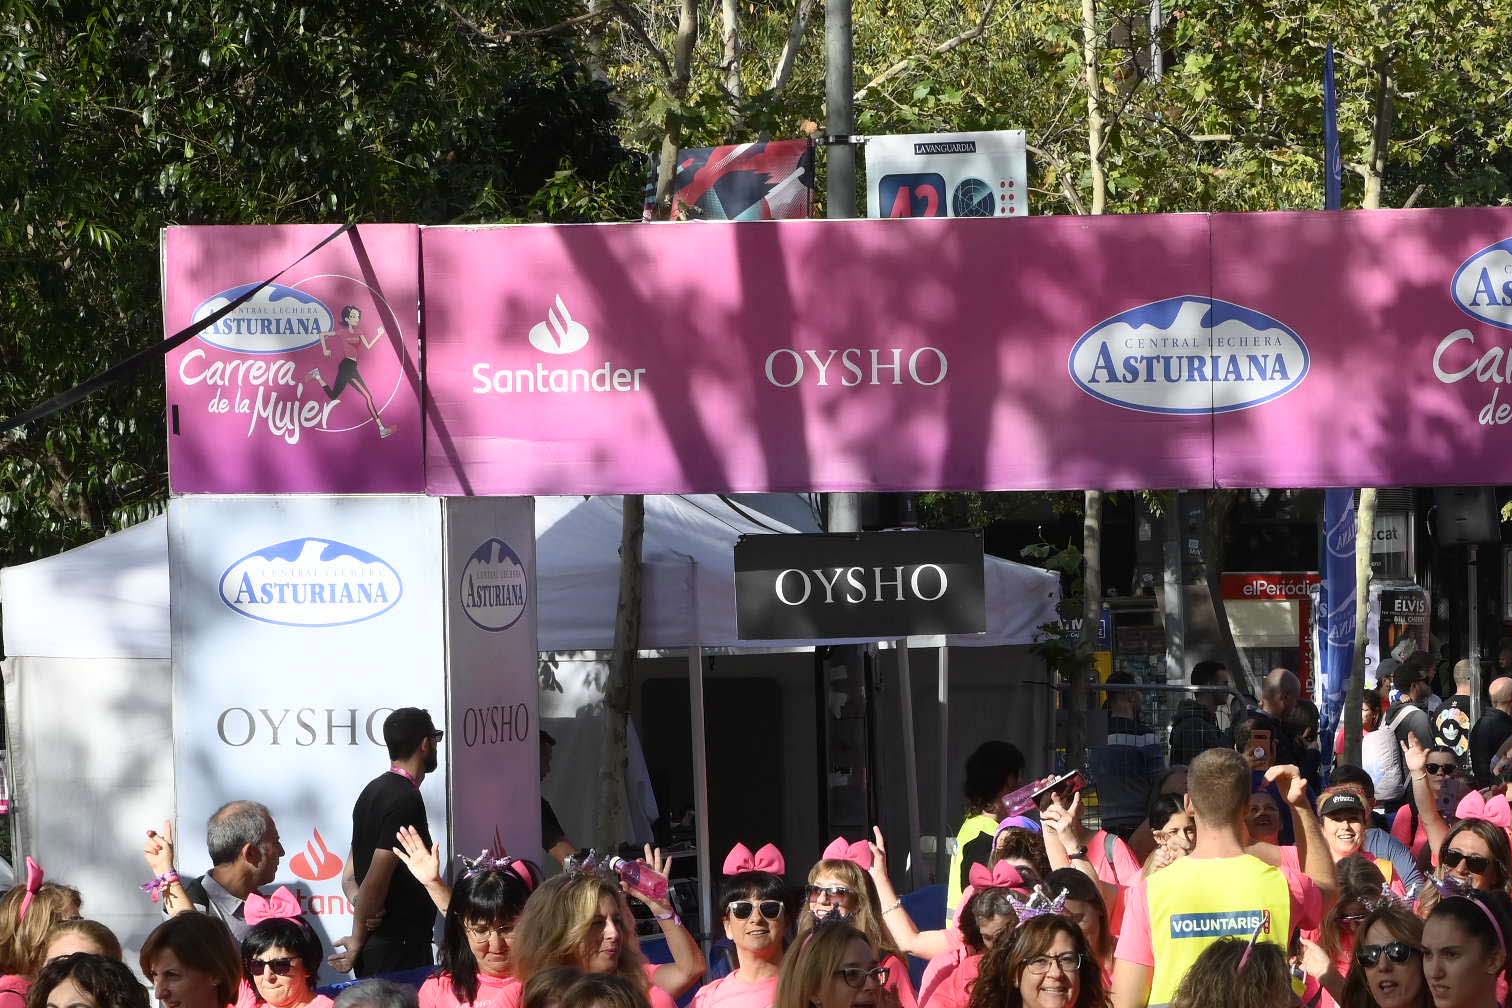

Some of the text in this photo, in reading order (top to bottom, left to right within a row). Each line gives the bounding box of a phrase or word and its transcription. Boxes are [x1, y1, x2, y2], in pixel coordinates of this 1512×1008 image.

[1125, 336, 1282, 349] CENTRAL LECHERA
[179, 348, 296, 386] Carrera
[472, 362, 646, 395] Santander
[764, 346, 949, 388] OYSHO
[1088, 341, 1291, 384] ASTURIANA
[208, 382, 341, 445] de la Mujer
[1478, 388, 1512, 425] de
[234, 570, 390, 605] ASTURIANA
[466, 574, 524, 610] ASTURIANA
[773, 563, 949, 607] OYSHO
[1394, 599, 1425, 612] ELVIS
[463, 702, 529, 748] OYSHO
[1173, 916, 1261, 933] VOLUNTARIS
